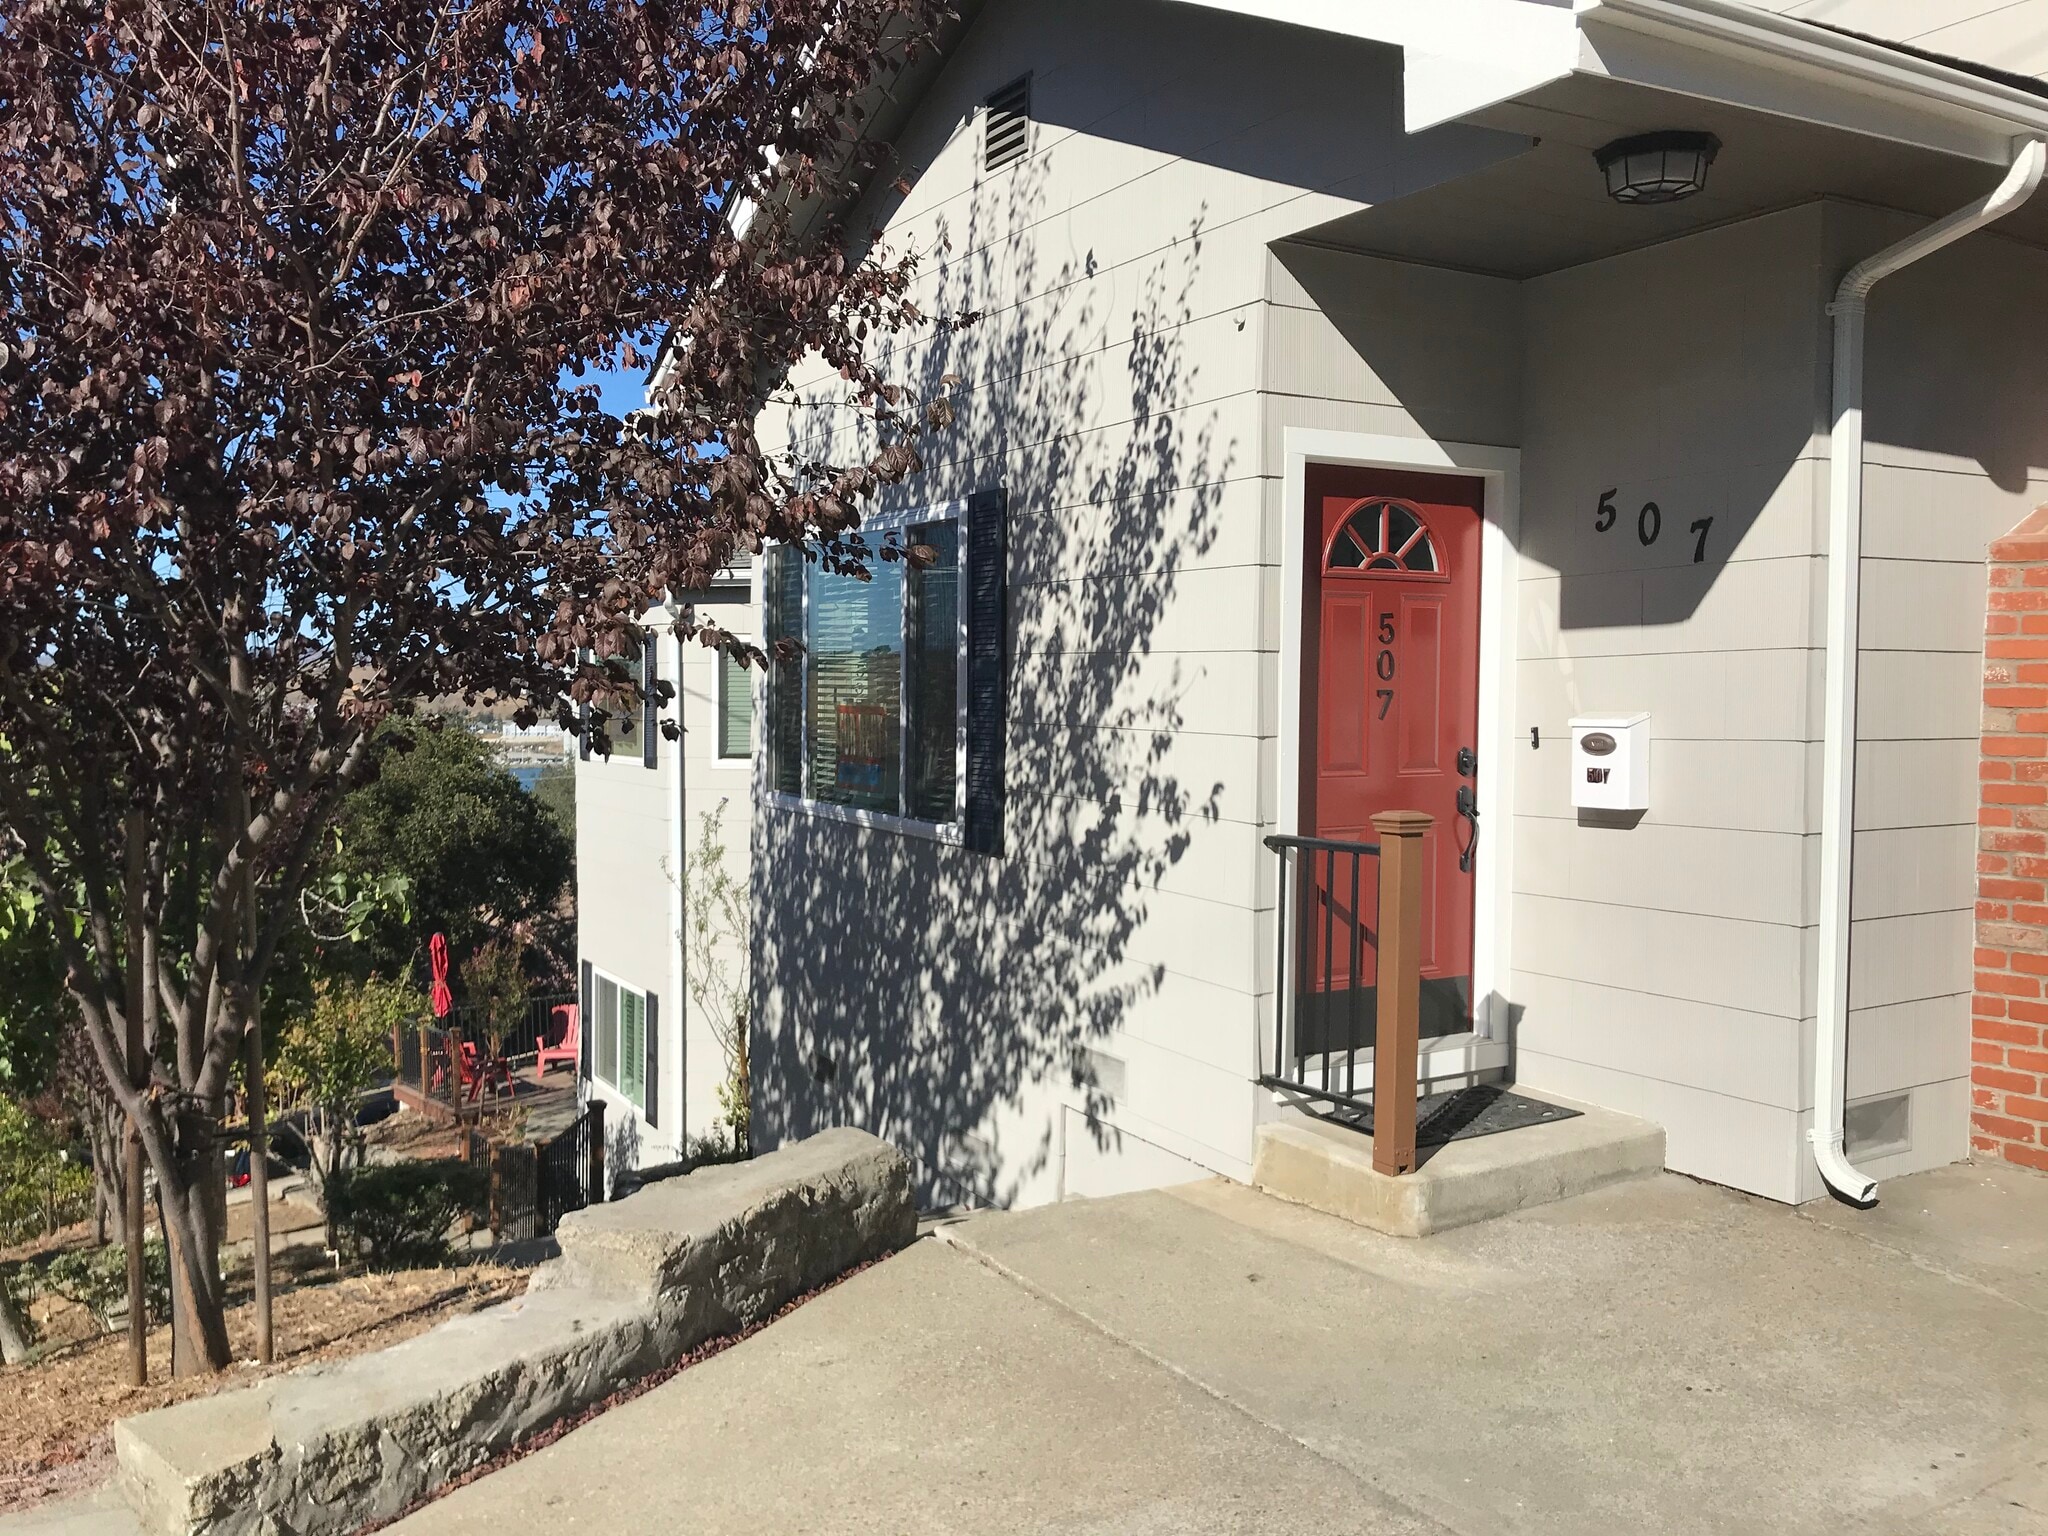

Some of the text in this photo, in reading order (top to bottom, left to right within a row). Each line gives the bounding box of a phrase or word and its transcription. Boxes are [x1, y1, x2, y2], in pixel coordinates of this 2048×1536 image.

[1595, 488, 1713, 563] 507
[1377, 613, 1395, 720] 507
[1587, 768, 1611, 784] 507
